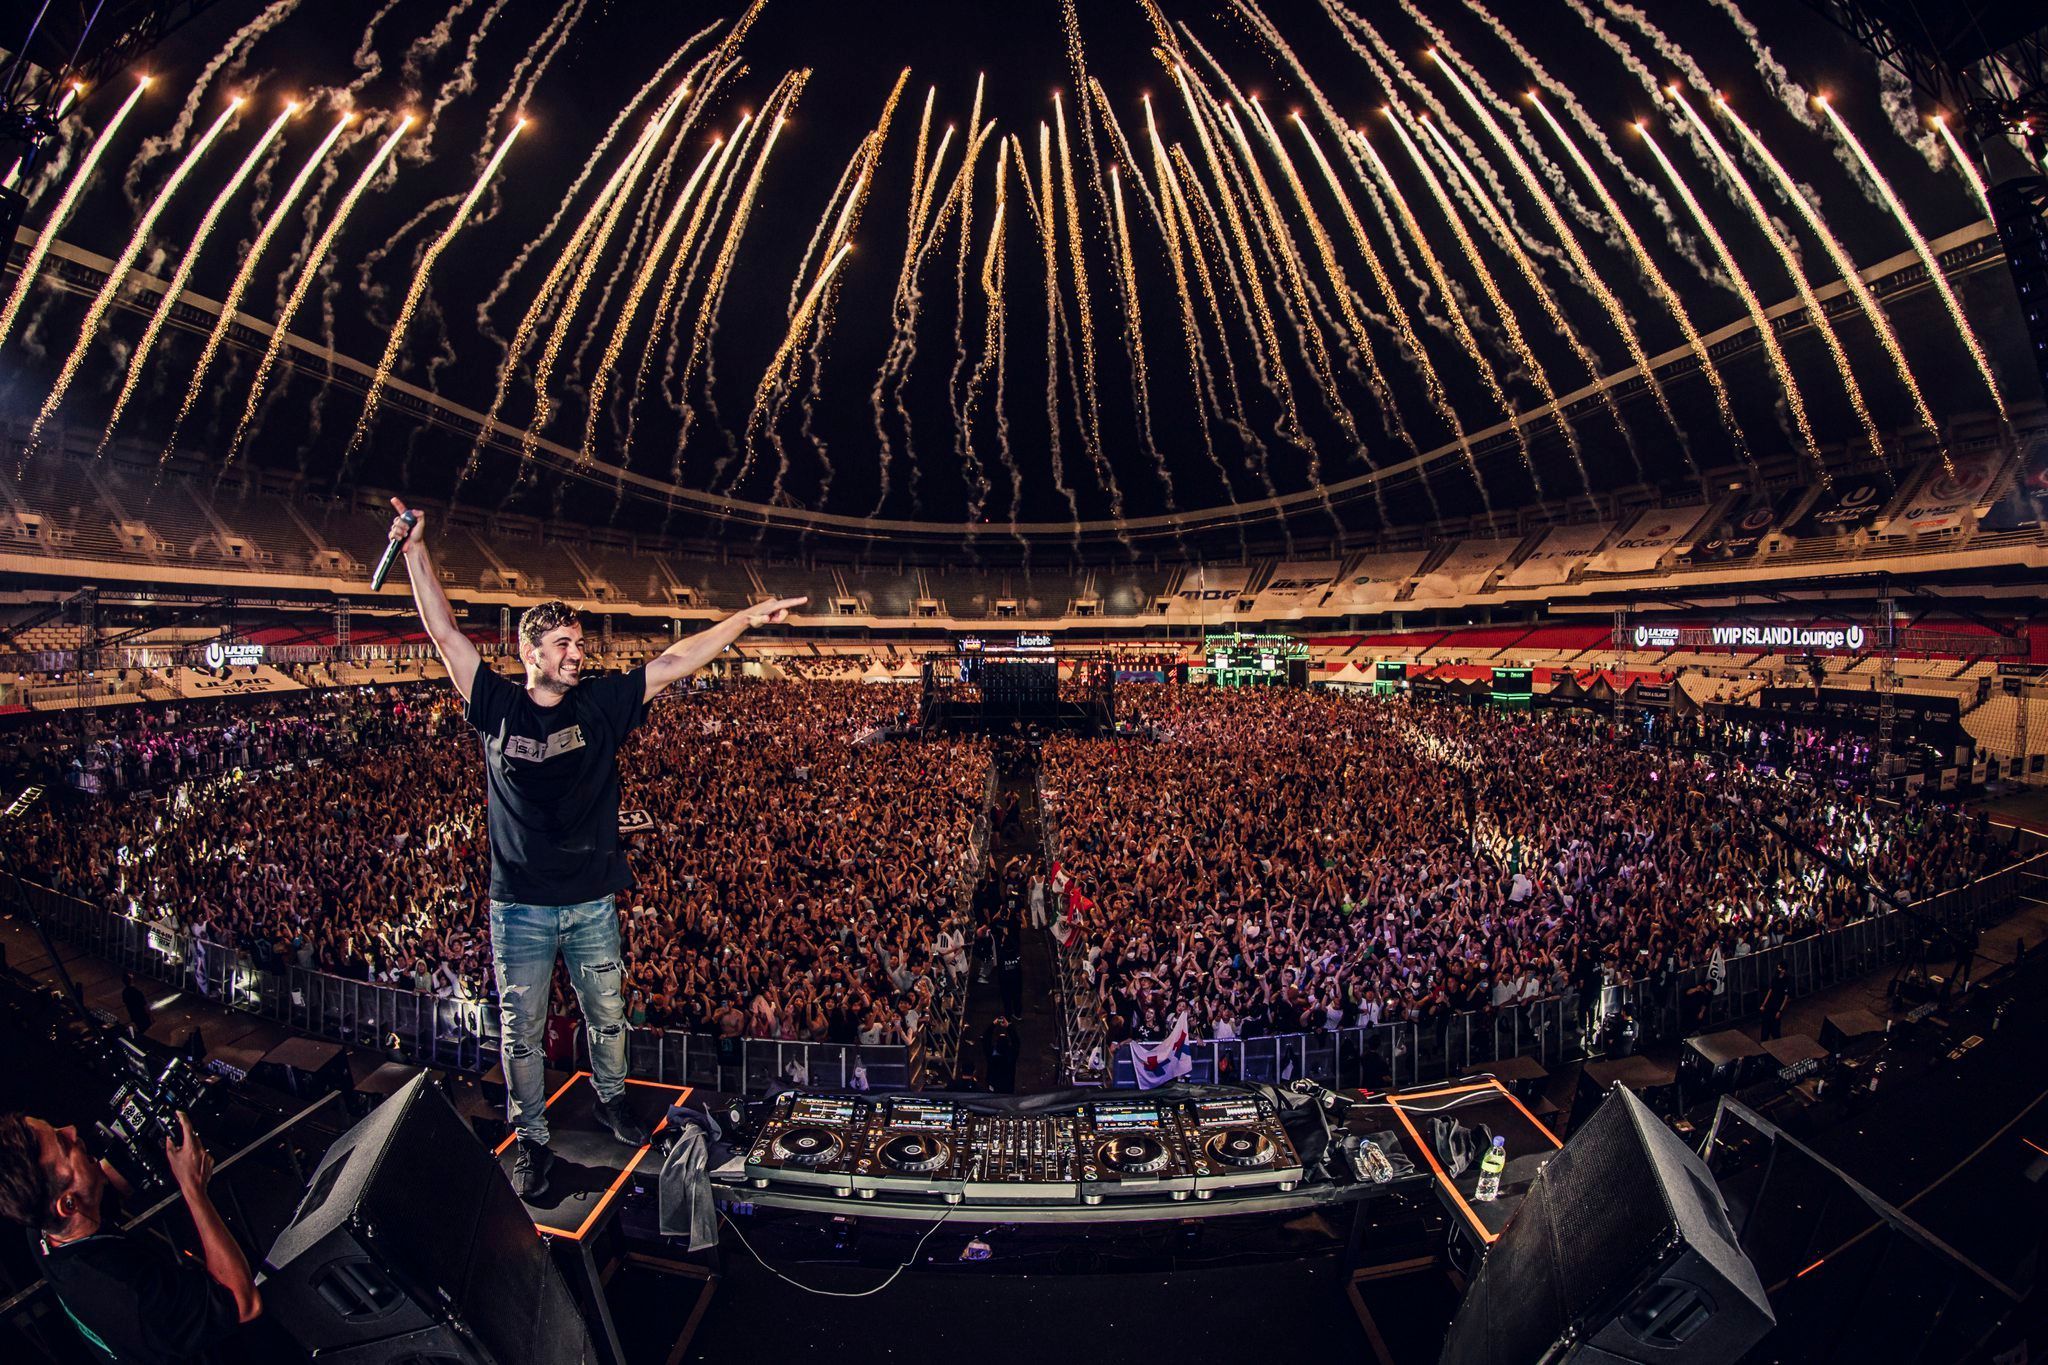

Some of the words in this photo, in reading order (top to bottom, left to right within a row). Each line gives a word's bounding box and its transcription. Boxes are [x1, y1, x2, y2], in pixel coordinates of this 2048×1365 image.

[1648, 628, 1679, 637] ULTRA
[1651, 638, 1675, 646] KOREA
[1712, 627, 1742, 645] VVIP
[1742, 627, 1792, 645] ISLAND
[1792, 627, 1844, 649] Lounge
[224, 645, 264, 656] ULTRA
[230, 657, 258, 666] KOREA
